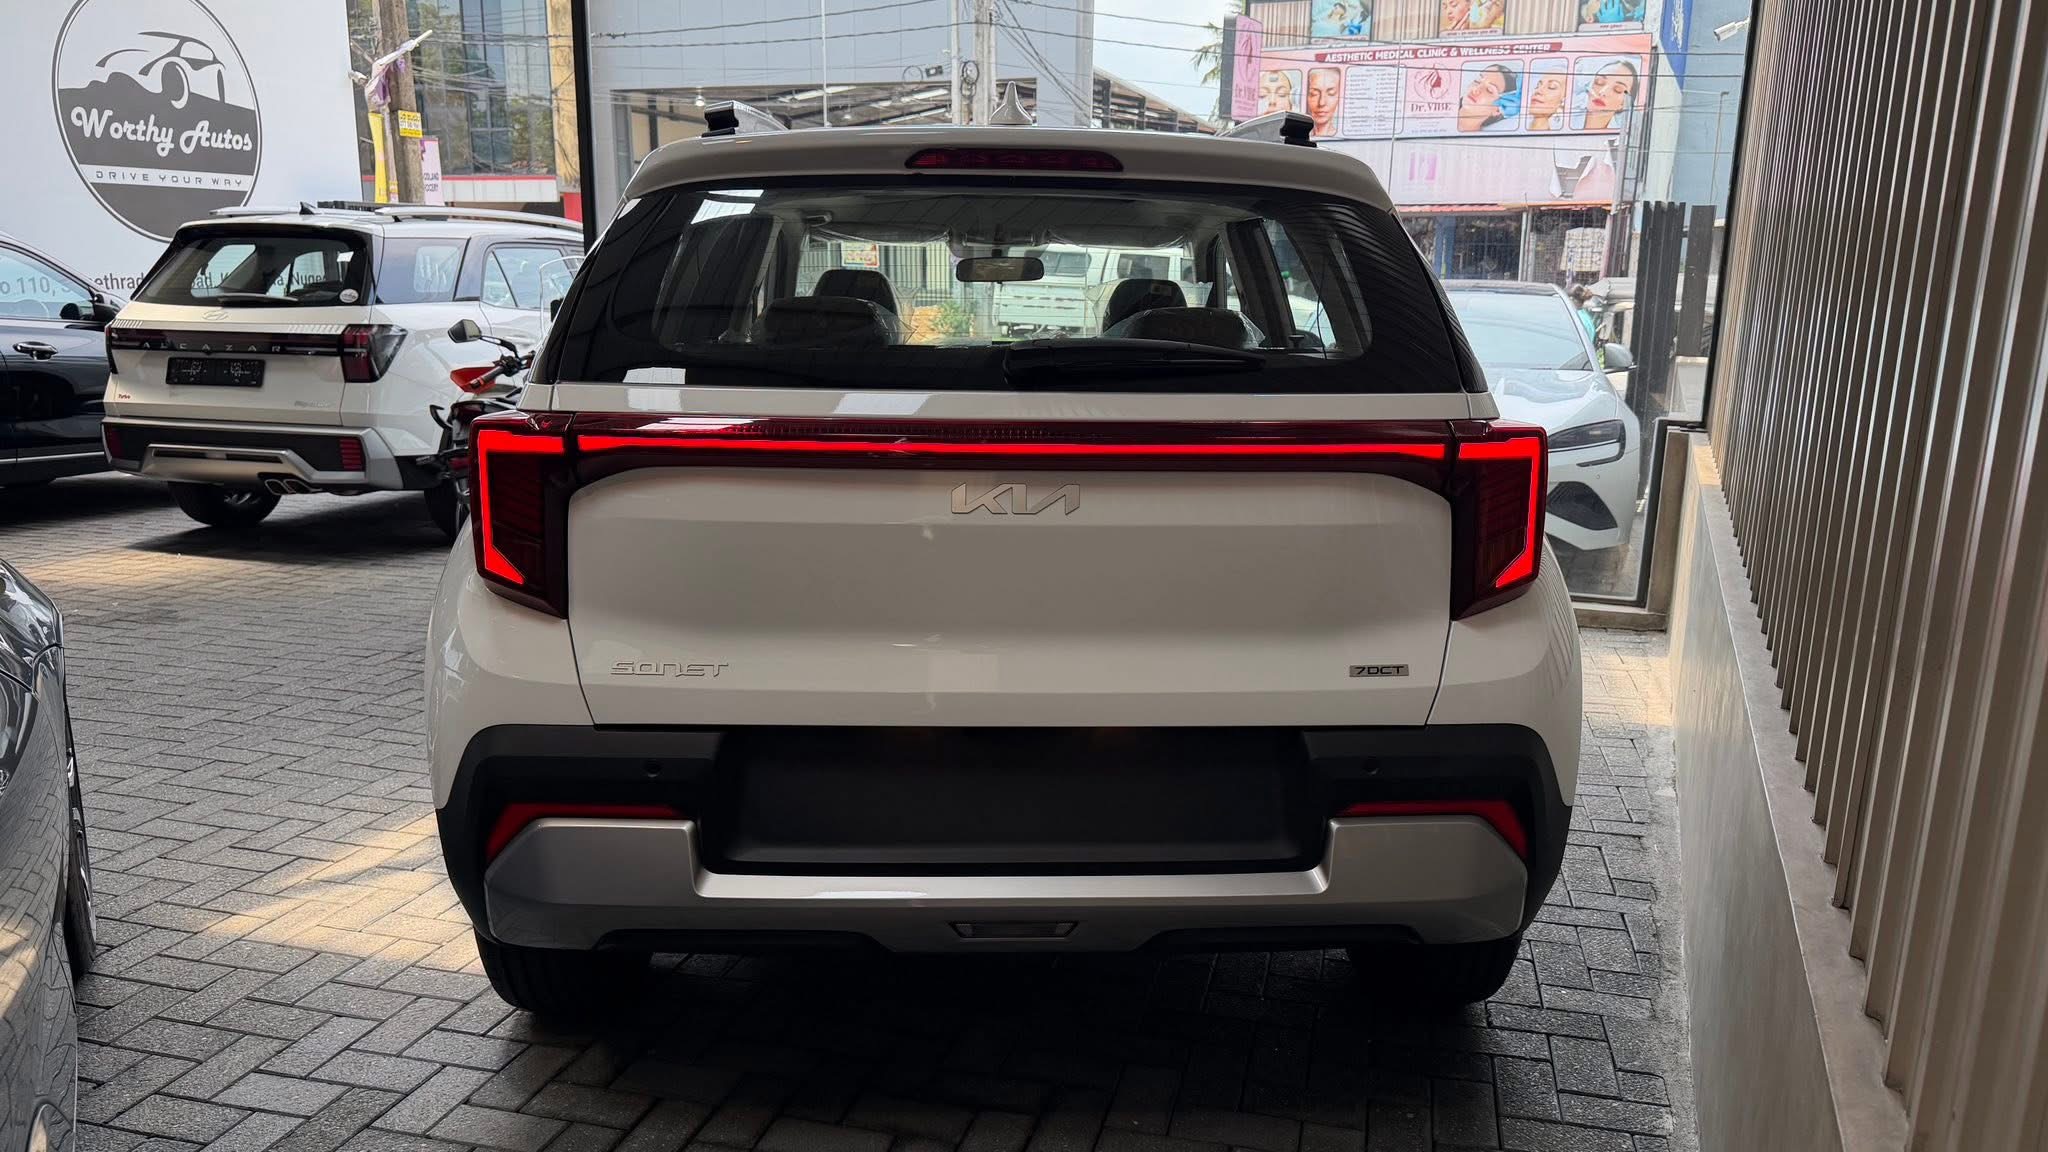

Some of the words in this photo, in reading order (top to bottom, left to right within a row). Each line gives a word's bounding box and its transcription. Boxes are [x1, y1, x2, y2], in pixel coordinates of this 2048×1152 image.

[1325, 52, 1373, 62] AESTHETIC
[1375, 50, 1415, 61] MEDICAL
[1417, 49, 1448, 59] CLINIC
[1450, 48, 1458, 57] &
[1460, 46, 1511, 56] WELLNESS
[1513, 44, 1551, 54] CENTER
[70, 106, 174, 157] Worthy
[179, 120, 252, 154] Autos
[95, 171, 149, 181] DRIVE
[159, 174, 203, 185] YOUR
[211, 178, 242, 186] WAY
[16, 275, 56, 297] 110,
[143, 342, 281, 352] ALCAZAR
[951, 482, 1080, 515] KIA
[610, 661, 729, 678] SONET
[1354, 665, 1405, 675] 7DCT
